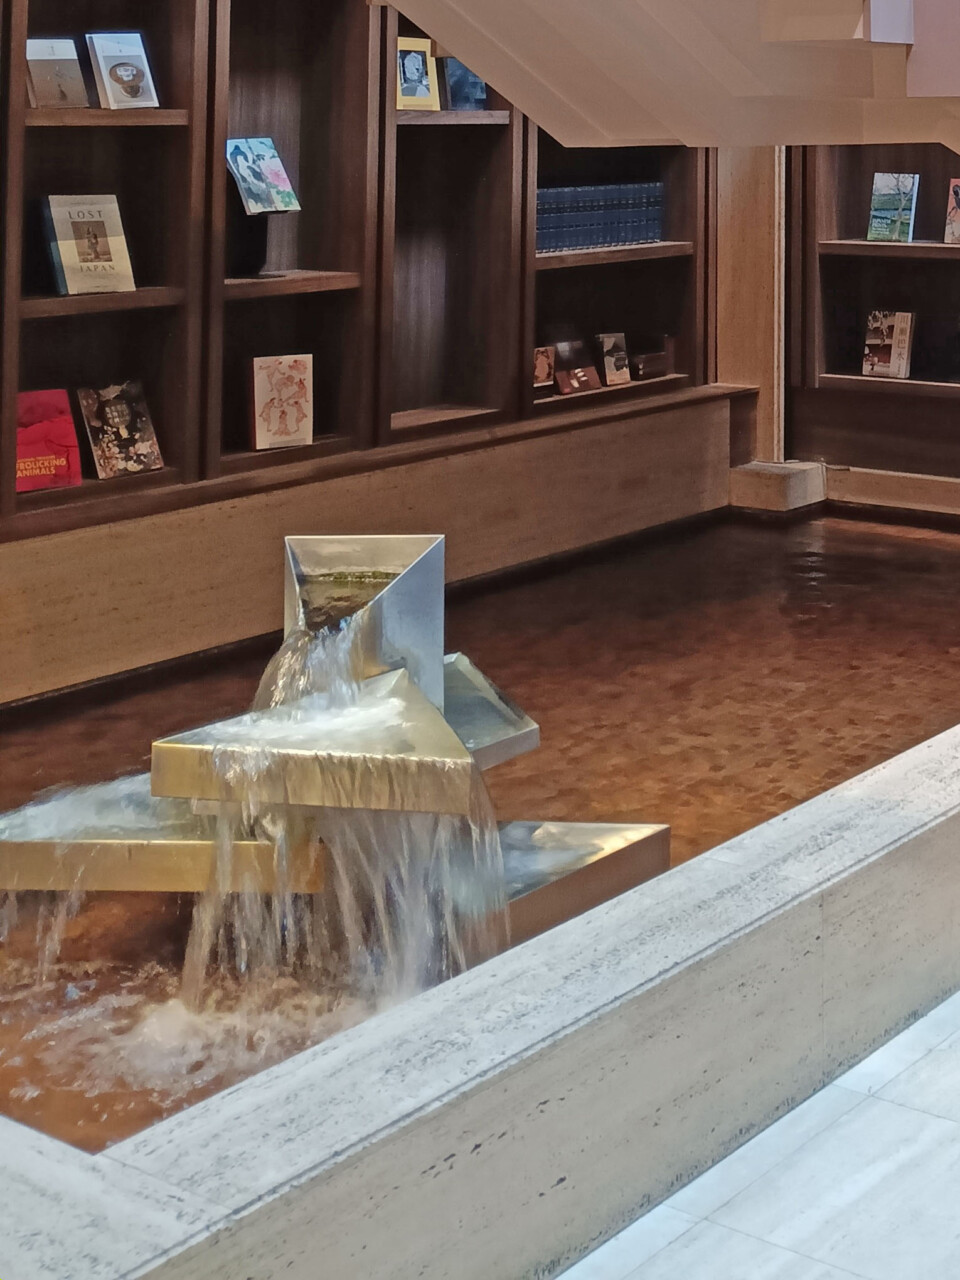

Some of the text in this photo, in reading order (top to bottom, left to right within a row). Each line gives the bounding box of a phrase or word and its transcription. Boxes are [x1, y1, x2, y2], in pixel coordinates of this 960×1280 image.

[68, 210, 103, 220] LOST
[80, 265, 116, 273] JAPAN
[16, 458, 66, 469] FROLICKING
[16, 466, 56, 477] ANIMALS
